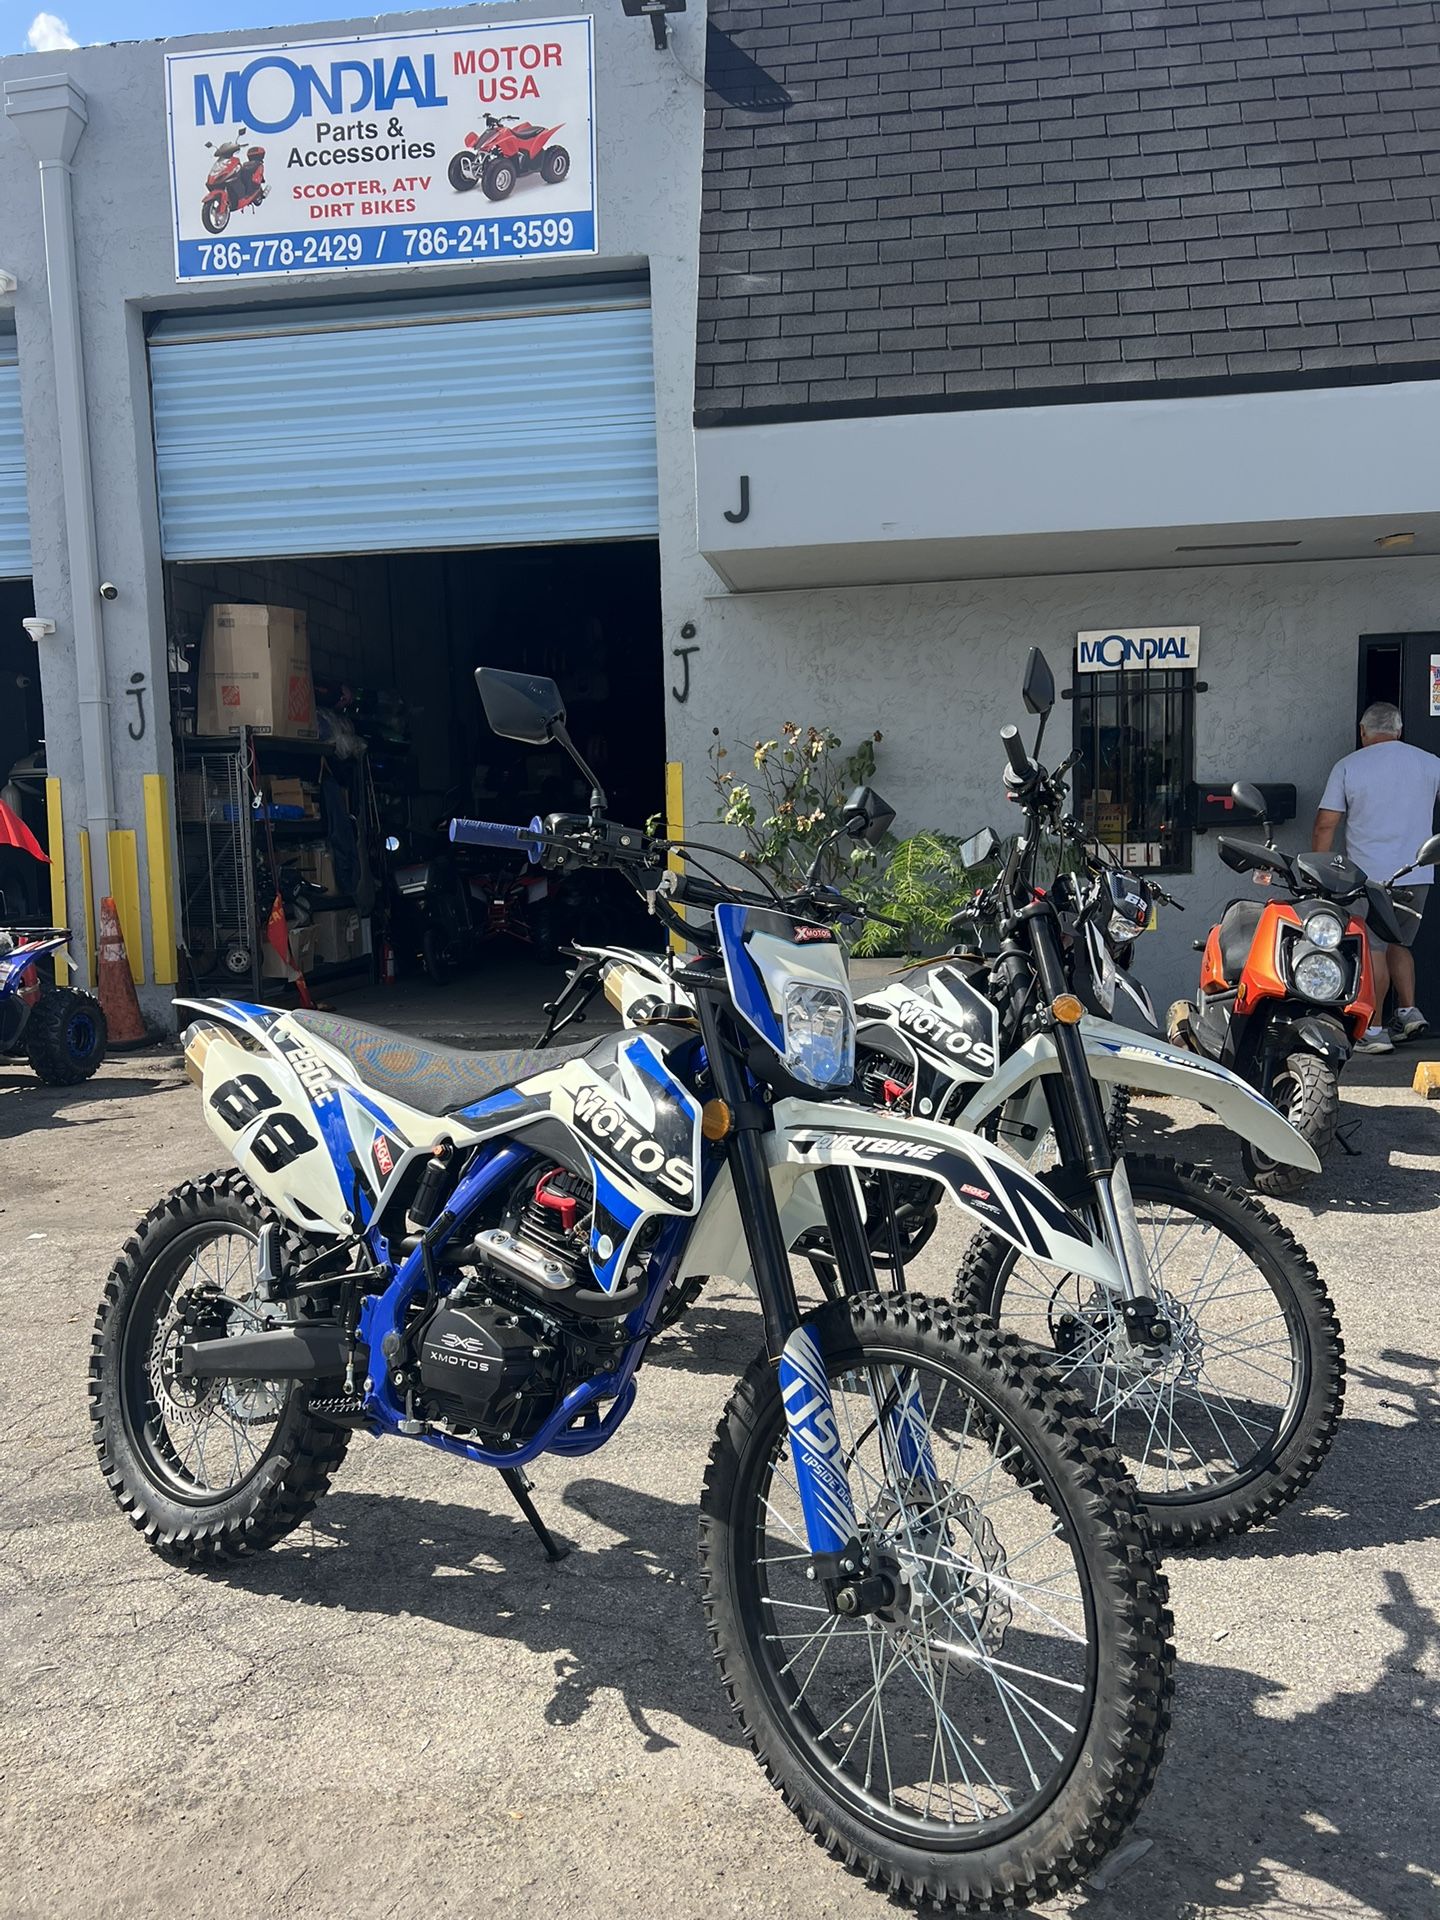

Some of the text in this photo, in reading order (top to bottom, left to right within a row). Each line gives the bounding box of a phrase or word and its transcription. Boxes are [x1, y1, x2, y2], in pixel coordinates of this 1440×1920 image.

[454, 43, 562, 75] MOTOR
[194, 53, 448, 134] MONDIAL
[479, 75, 540, 103] USA
[316, 117, 404, 143] Parts &
[287, 139, 436, 168] Accessories
[292, 176, 432, 199] SCOOTER, ATV
[310, 198, 416, 219] DIRT BIKES
[198, 217, 574, 270] 786-778-2429 / 786-241-3599
[724, 475, 750, 523] J
[1080, 635, 1190, 666] MONDIAL
[899, 1001, 994, 1068] MOTOS
[375, 1136, 394, 1175] NGK
[574, 1087, 695, 1196] MOTOS
[816, 1132, 946, 1161] DIRTBIKE
[430, 1351, 489, 1372] XMOTOS
[802, 1453, 838, 1489] UPSIDE
